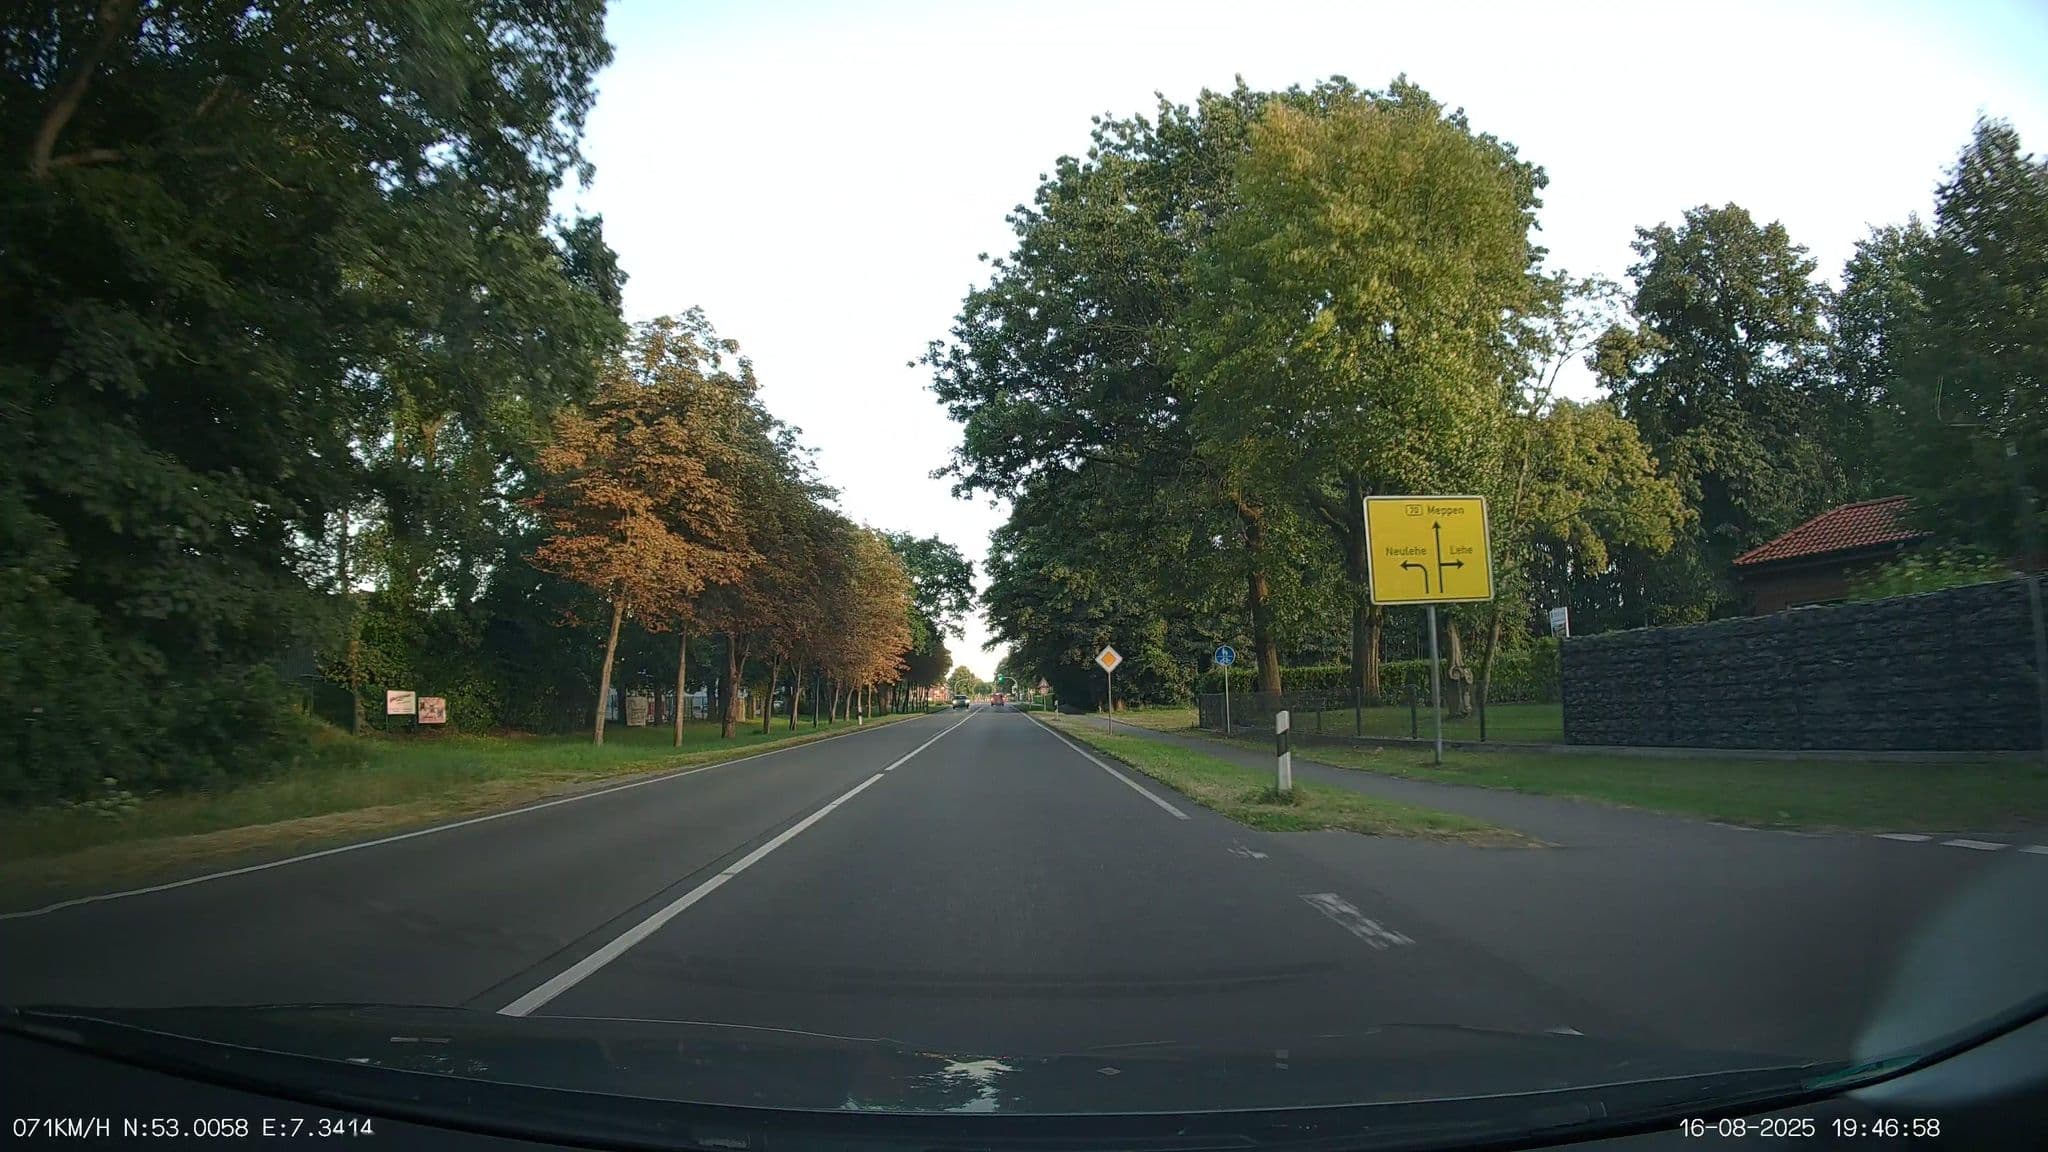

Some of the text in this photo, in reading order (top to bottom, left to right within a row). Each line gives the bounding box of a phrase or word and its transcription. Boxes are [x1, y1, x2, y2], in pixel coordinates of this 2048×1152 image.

[1427, 505, 1464, 517] Meppen
[1385, 546, 1427, 556] Neulehe
[1450, 545, 1473, 555] Lehe
